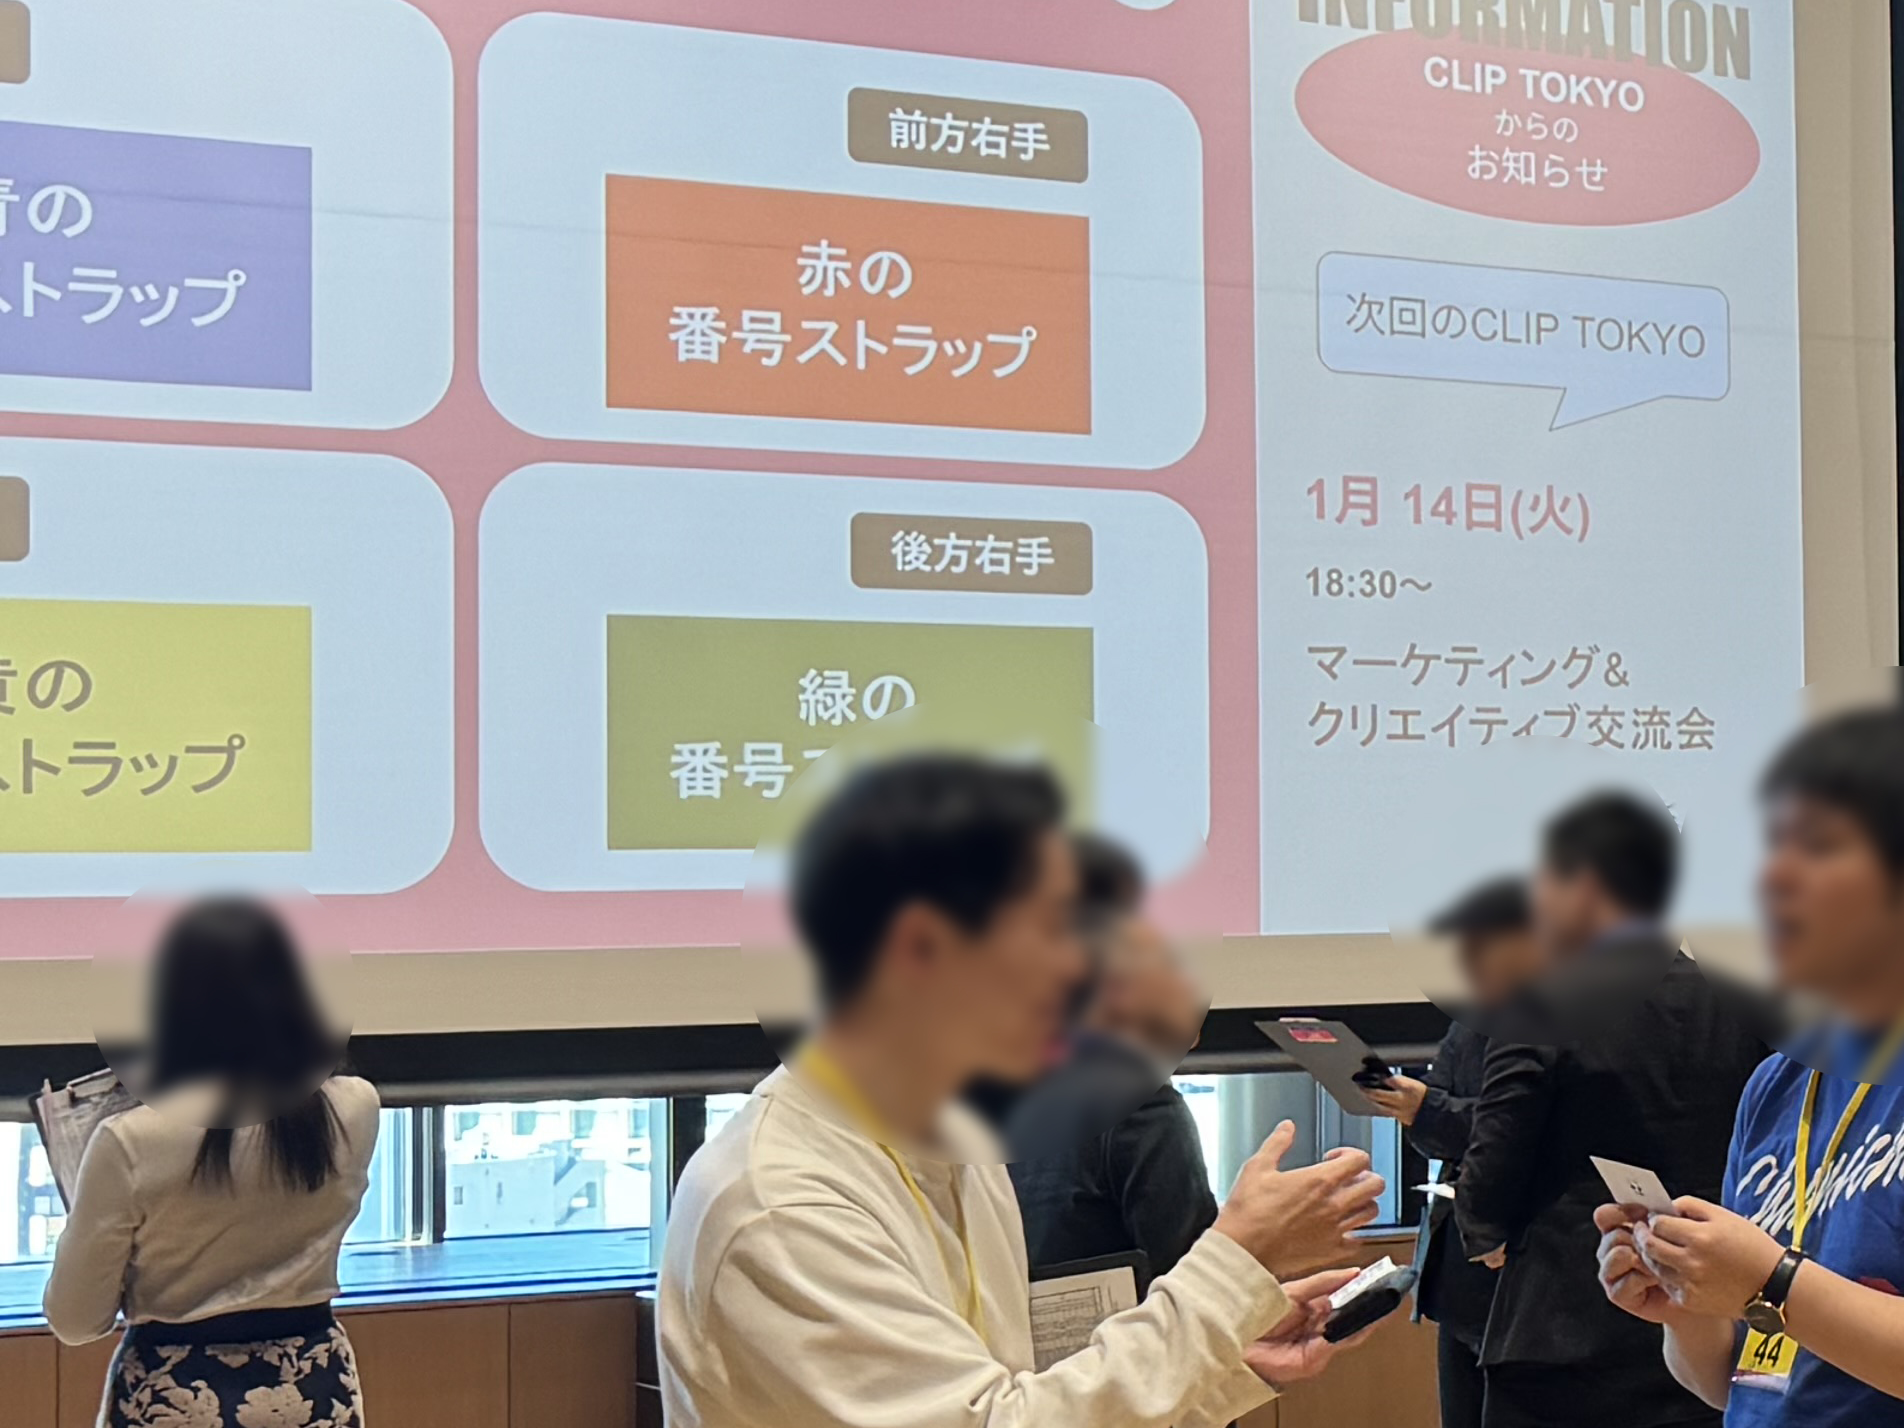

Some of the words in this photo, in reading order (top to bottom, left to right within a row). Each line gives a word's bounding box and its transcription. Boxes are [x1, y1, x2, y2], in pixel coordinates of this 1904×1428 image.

[1423, 55, 1508, 94] CLIP
[1518, 68, 1645, 113] TOKYO
[889, 109, 1050, 162] 前方右手
[1495, 109, 1578, 144] からの
[1466, 145, 1607, 192] お知らせ
[0, 178, 93, 239] の
[0, 261, 247, 328] トラップ
[797, 240, 912, 299] 赤の
[669, 305, 1036, 378] 番号ストラップ
[1345, 291, 1559, 346] 次回のCLIP
[1573, 315, 1706, 360] TOKYO
[1305, 475, 1380, 528] 1月
[1403, 481, 1590, 543] 14日(火)
[892, 530, 1055, 576] 後方右手
[0, 659, 93, 716] の
[1307, 641, 1629, 688] マーケティング&
[797, 669, 915, 726] 緑の
[1308, 702, 1716, 752] クリエイティブ交流会
[0, 733, 247, 797] トラップ
[1754, 1335, 1785, 1367] 44
